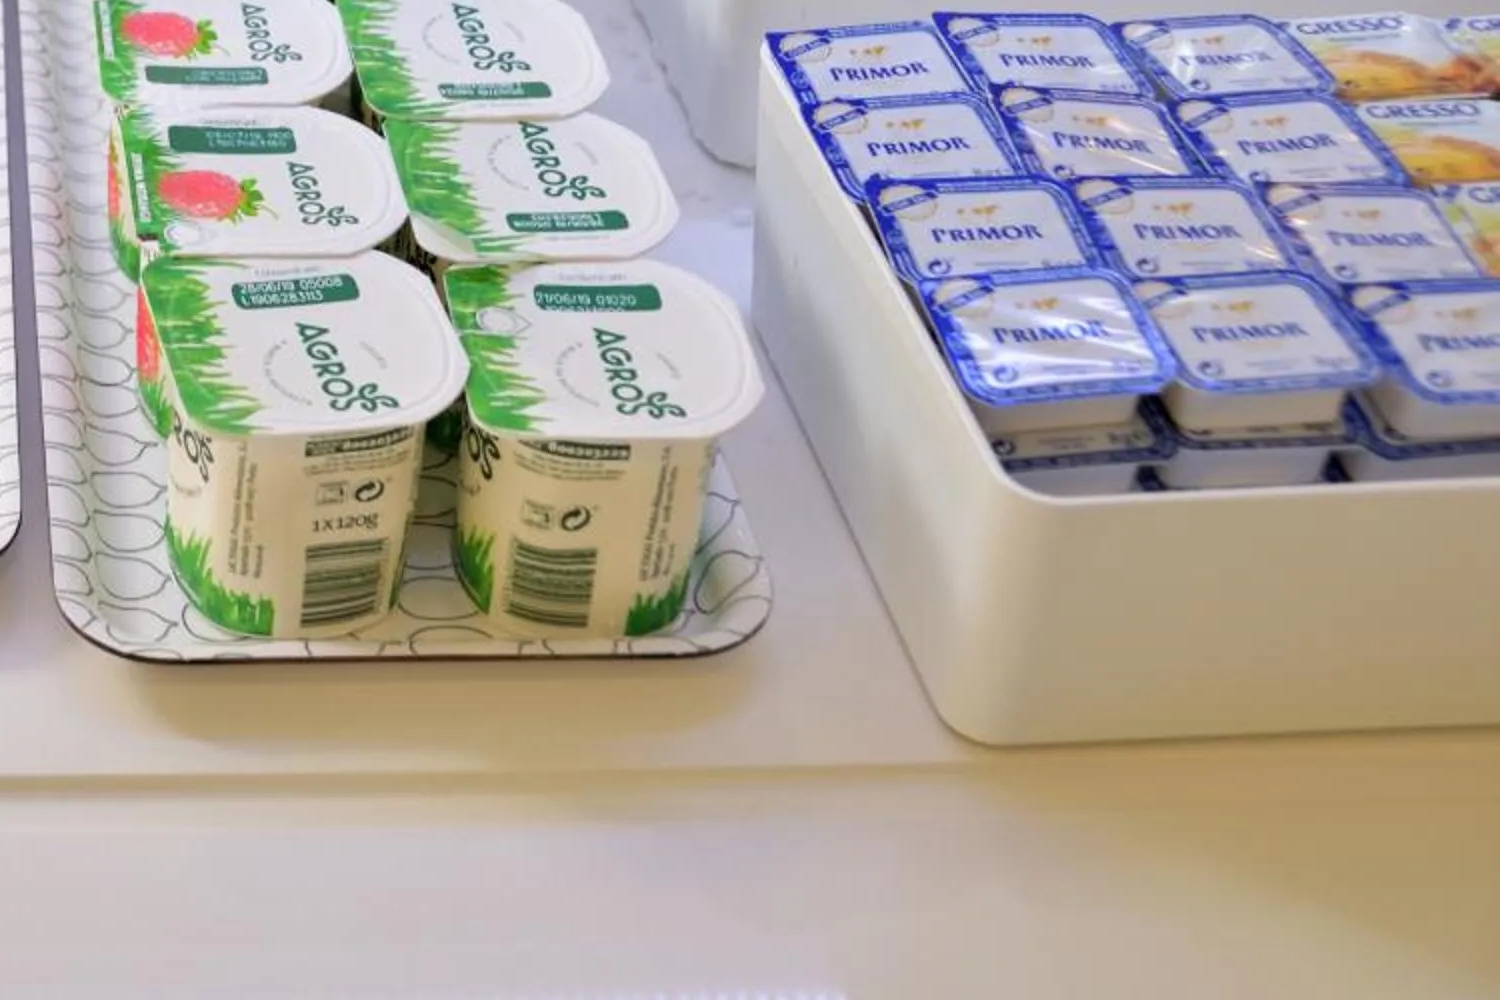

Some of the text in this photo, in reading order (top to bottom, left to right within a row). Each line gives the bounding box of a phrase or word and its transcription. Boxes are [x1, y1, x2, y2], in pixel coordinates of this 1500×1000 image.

[240, 2, 303, 63] AGROS
[451, 2, 532, 73] AGROS
[1297, 16, 1402, 36] GRESSO
[828, 61, 930, 82] PRIMOR
[1000, 53, 1095, 69] PRIMOR
[1365, 102, 1480, 119] GRESSO
[866, 136, 972, 158] PRIMOR
[1052, 131, 1153, 154] PRIMOR
[1236, 132, 1339, 156] PRIMOR
[517, 119, 607, 201] AGROS
[286, 160, 360, 227] AGROS
[931, 224, 1044, 244] PRIMOR
[1132, 222, 1244, 241] PRIMOR
[991, 319, 1111, 345] PRIMOR
[1191, 322, 1311, 344] PRIMOR
[294, 321, 400, 413] AGROS
[592, 326, 687, 420] AGROS
